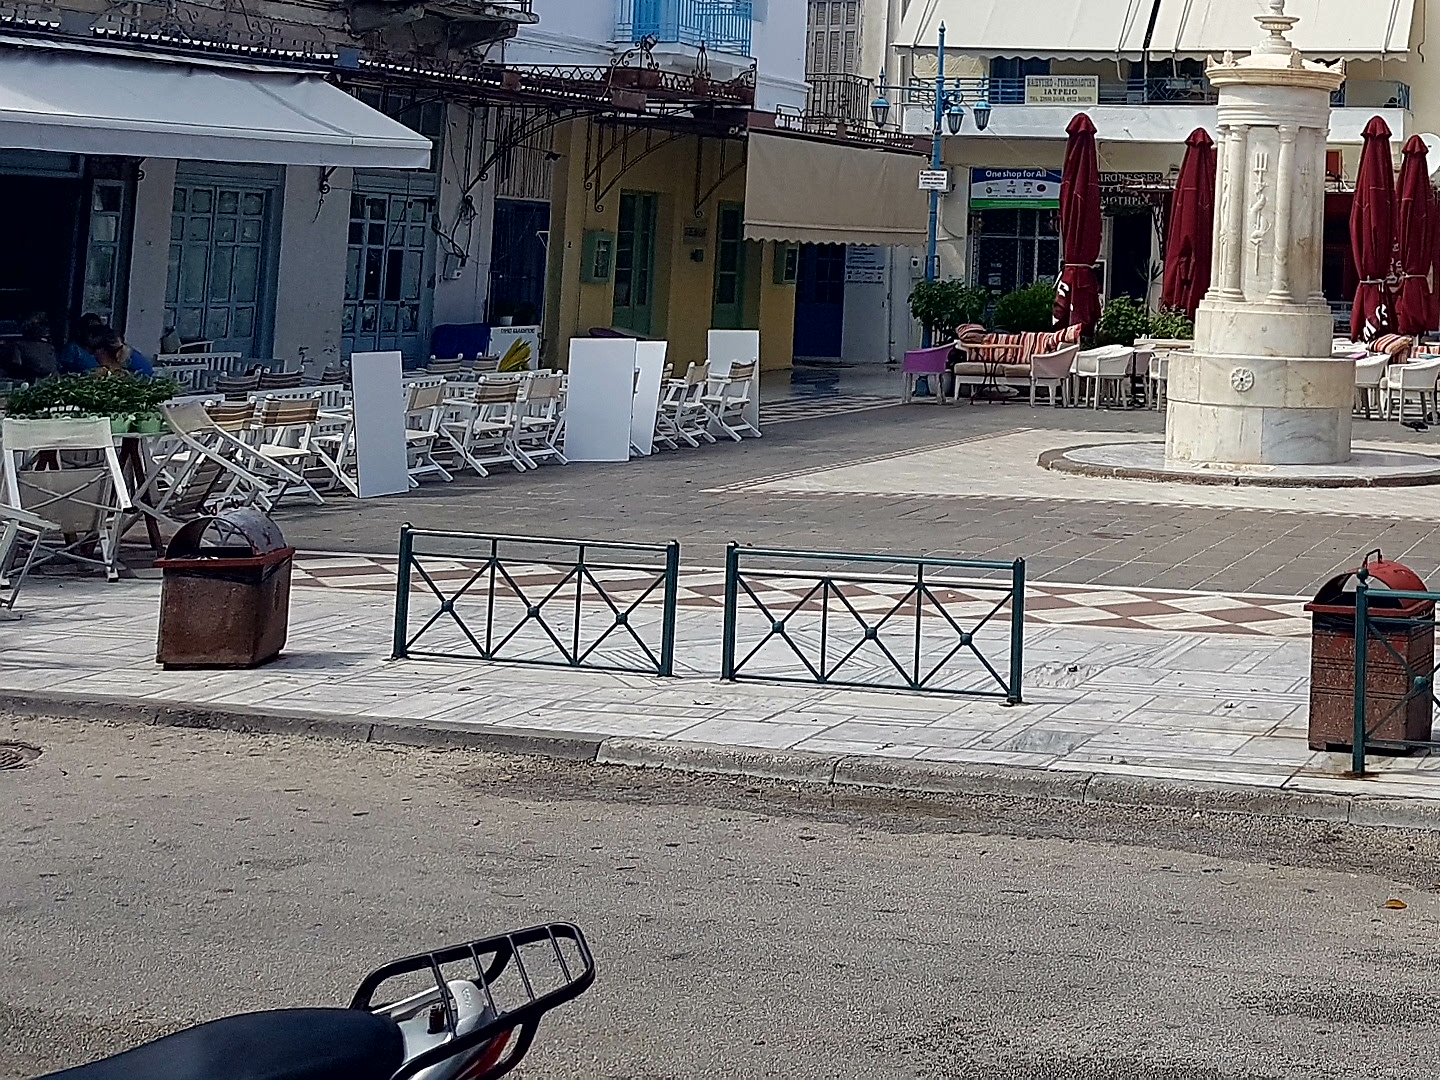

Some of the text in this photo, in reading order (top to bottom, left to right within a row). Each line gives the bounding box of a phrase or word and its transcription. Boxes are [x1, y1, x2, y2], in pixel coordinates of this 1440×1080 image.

[1043, 88, 1078, 96] ΙΑΤΡΕΙΟ
[985, 170, 1047, 179] One shop for All
